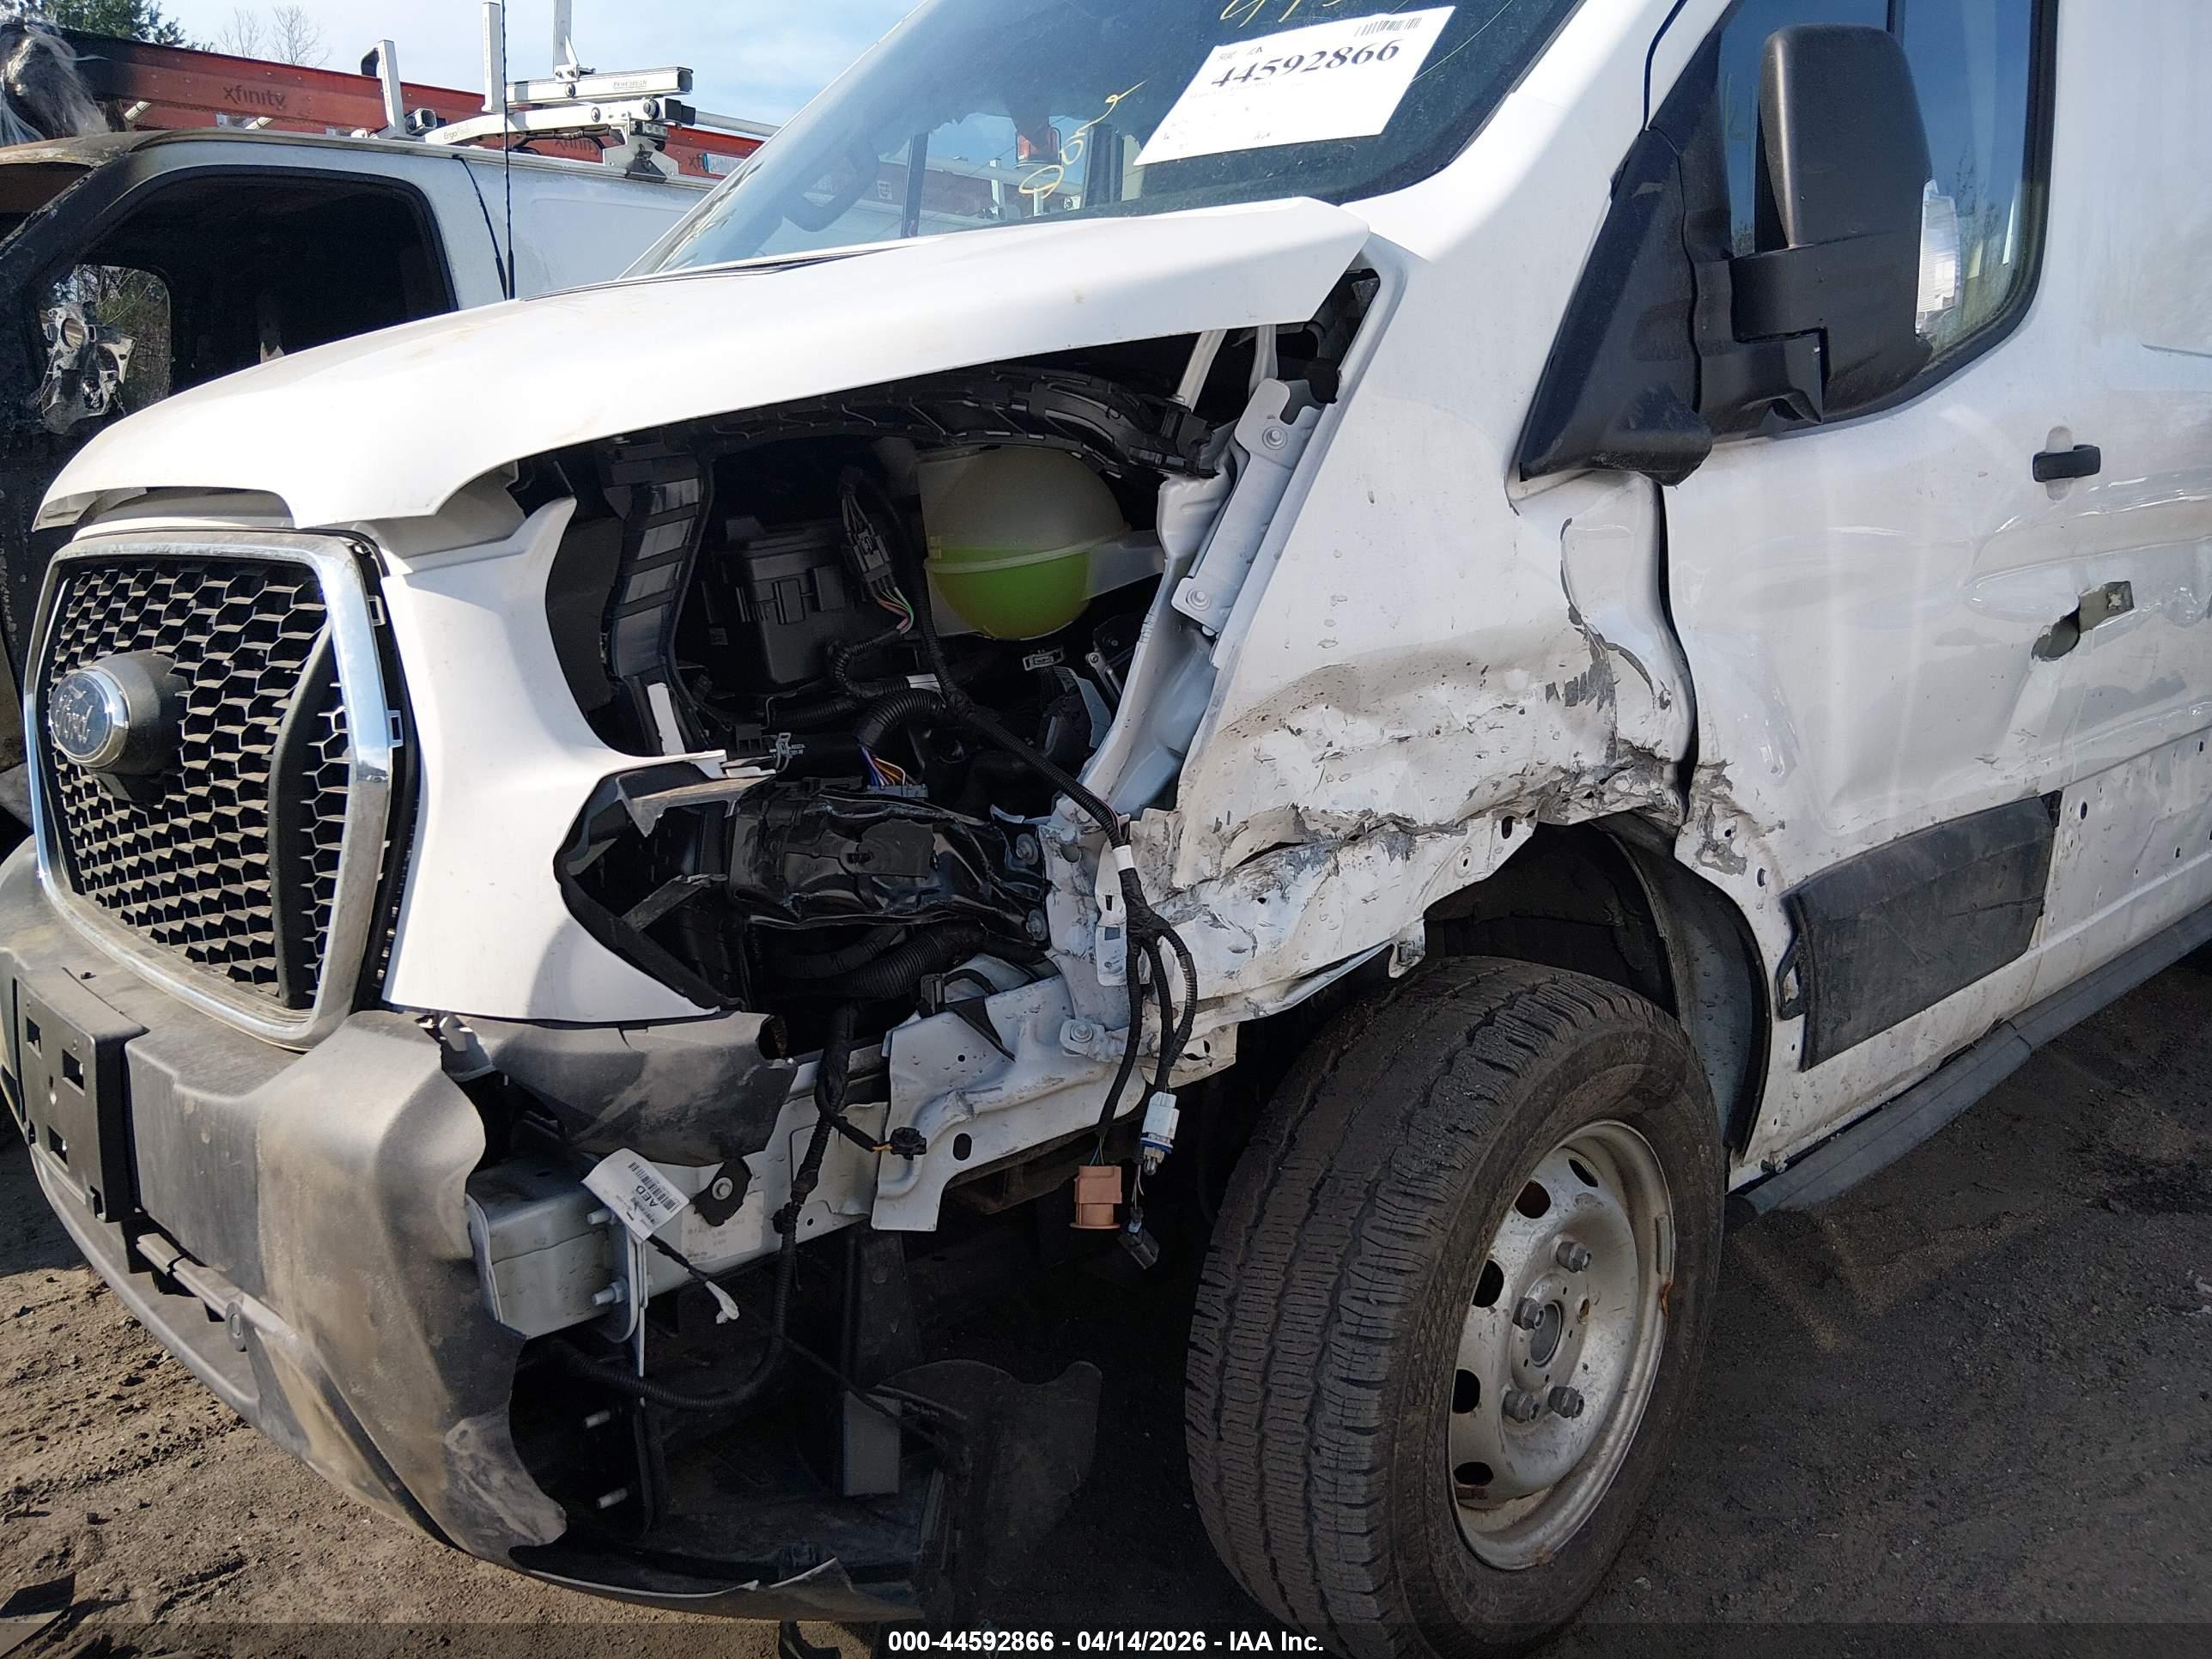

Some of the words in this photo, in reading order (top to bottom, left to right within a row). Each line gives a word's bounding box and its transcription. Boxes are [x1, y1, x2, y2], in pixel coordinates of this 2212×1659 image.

[1211, 38, 1404, 87] 44592866
[222, 84, 288, 111] xfinity
[635, 1185, 659, 1207] AED
